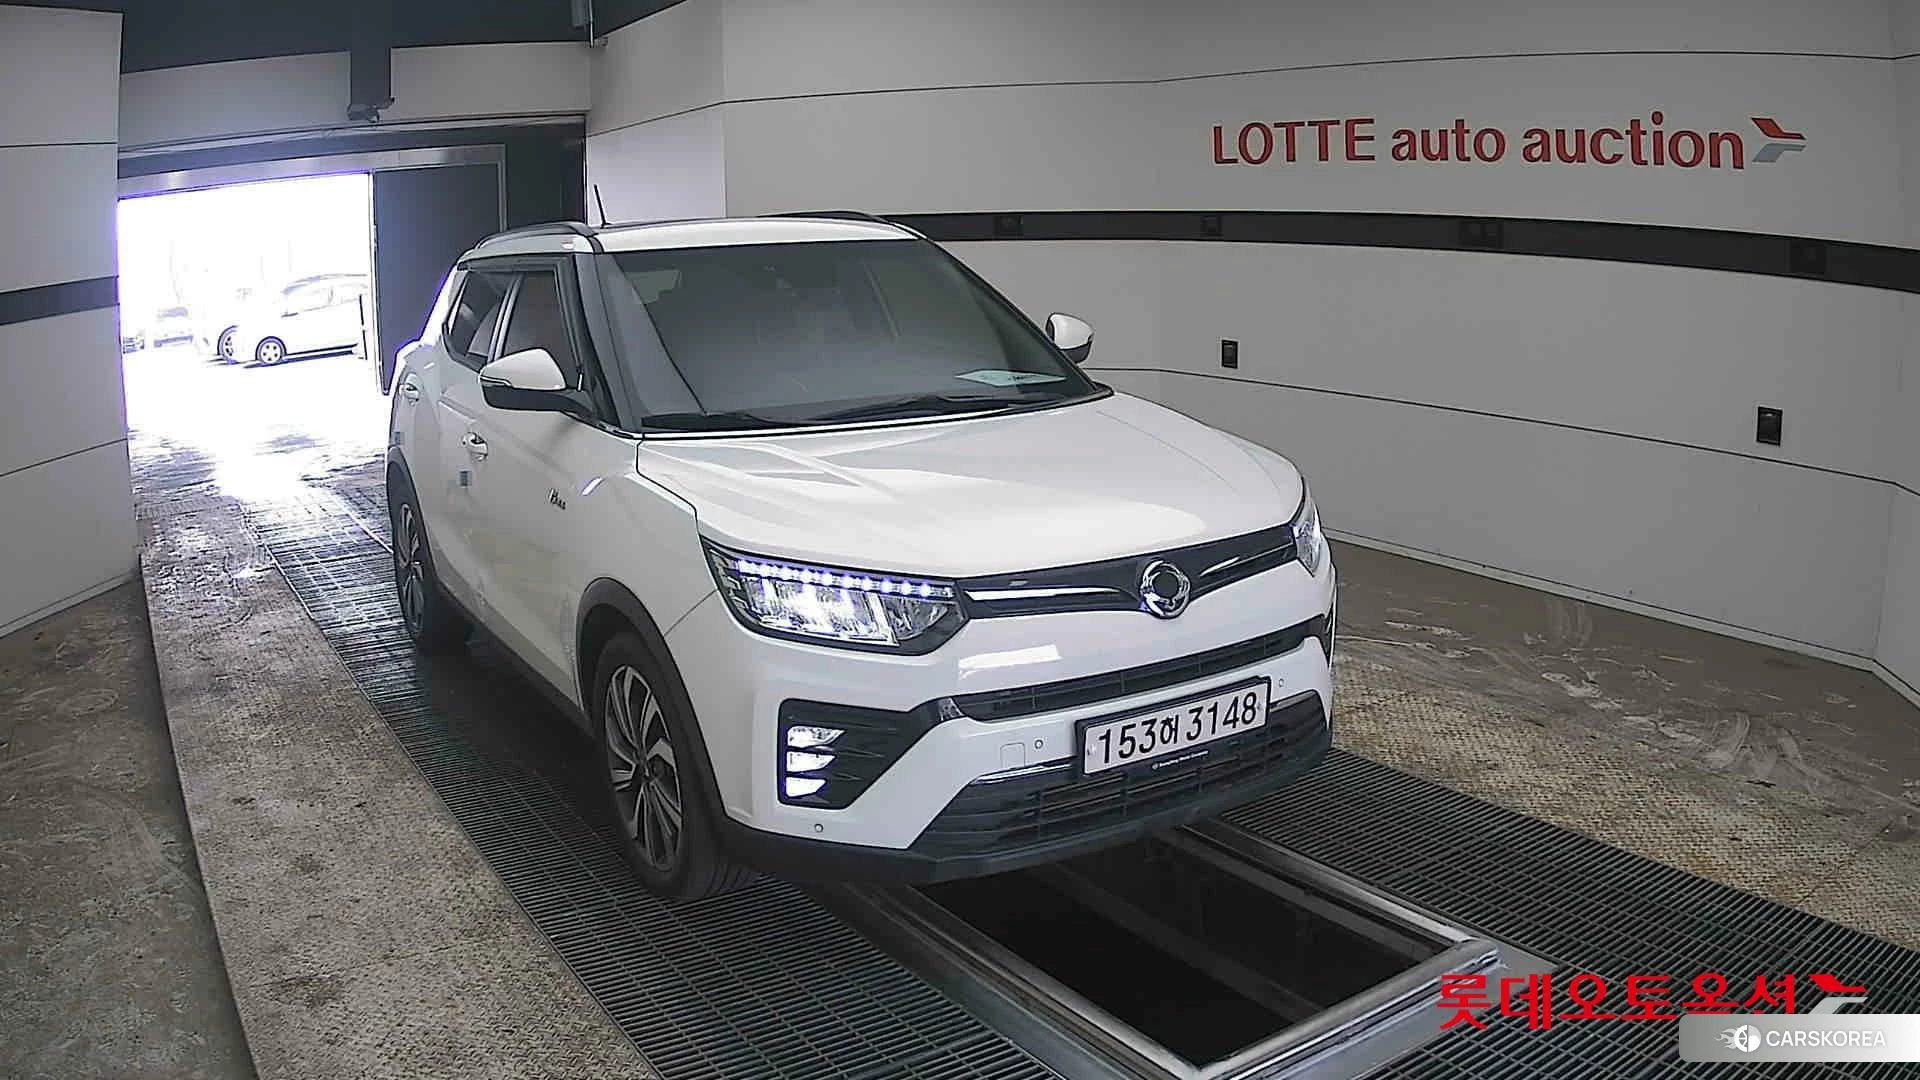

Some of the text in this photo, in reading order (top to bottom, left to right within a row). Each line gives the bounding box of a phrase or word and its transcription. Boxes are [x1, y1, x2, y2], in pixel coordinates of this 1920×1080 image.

[1212, 110, 1745, 170] LOTTE auto auction
[1186, 691, 1258, 742] 3148
